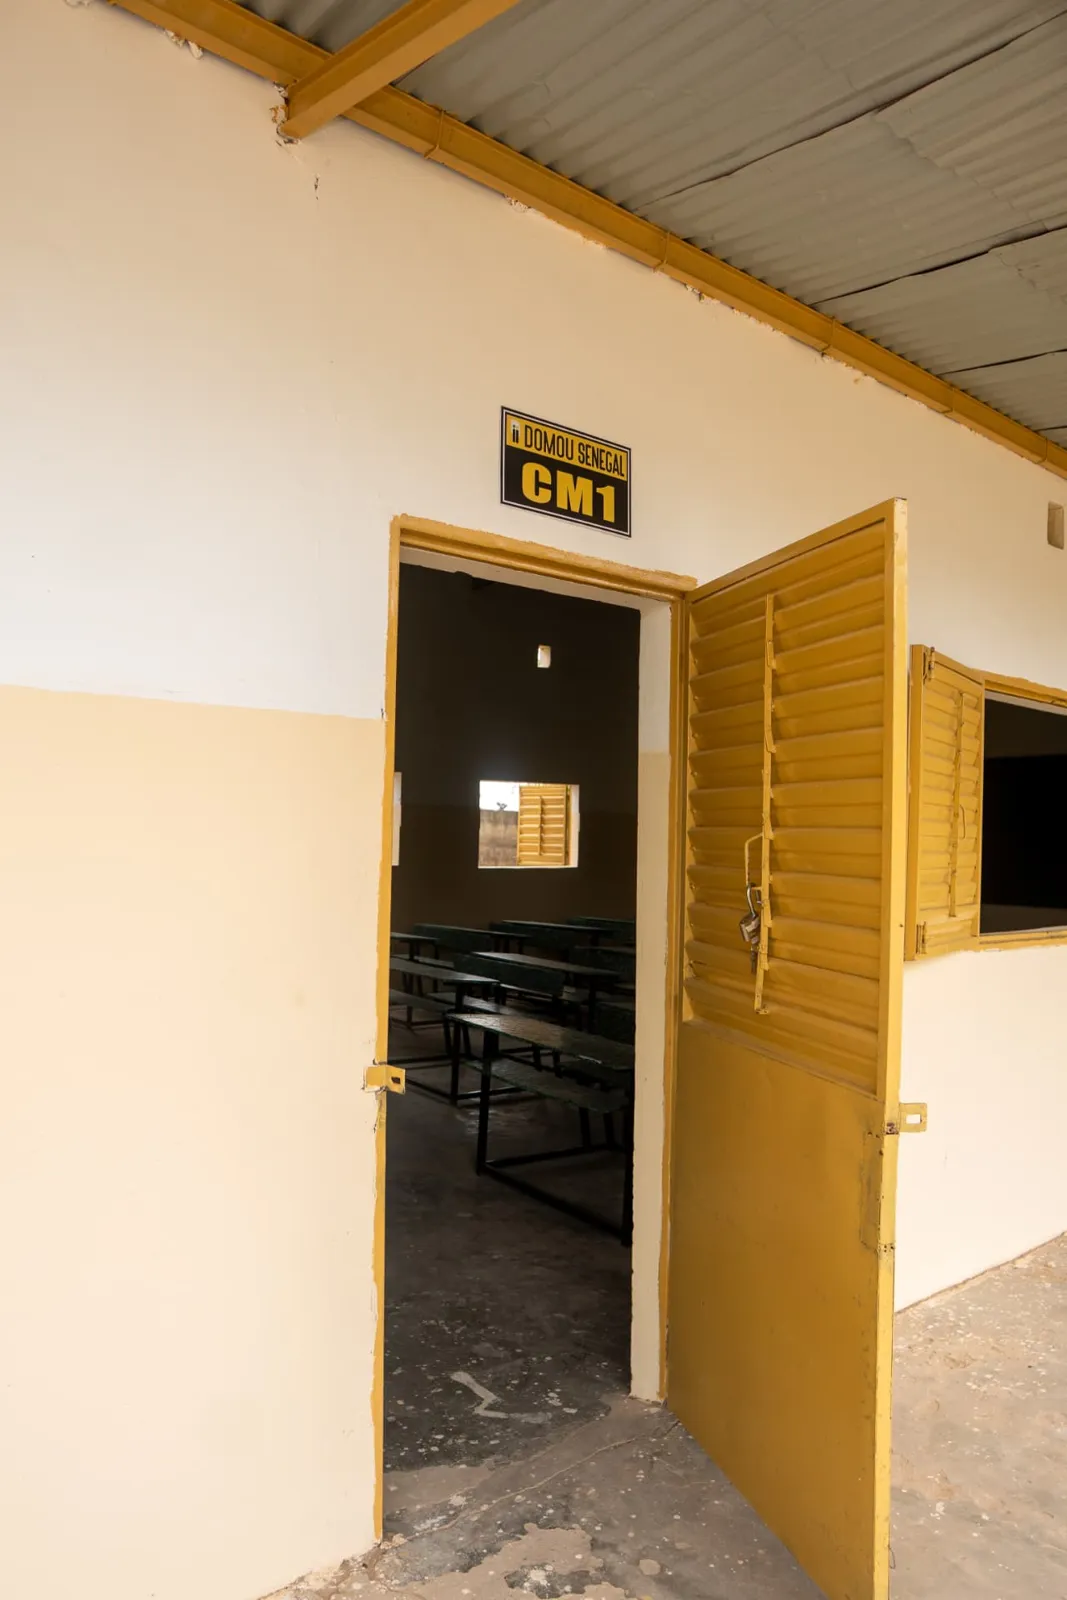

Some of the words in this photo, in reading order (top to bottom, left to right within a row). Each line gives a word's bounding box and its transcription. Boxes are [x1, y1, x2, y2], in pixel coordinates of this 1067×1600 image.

[524, 424, 574, 461] DOMOU
[577, 442, 625, 477] SENEGAL
[522, 462, 615, 523] CM1
